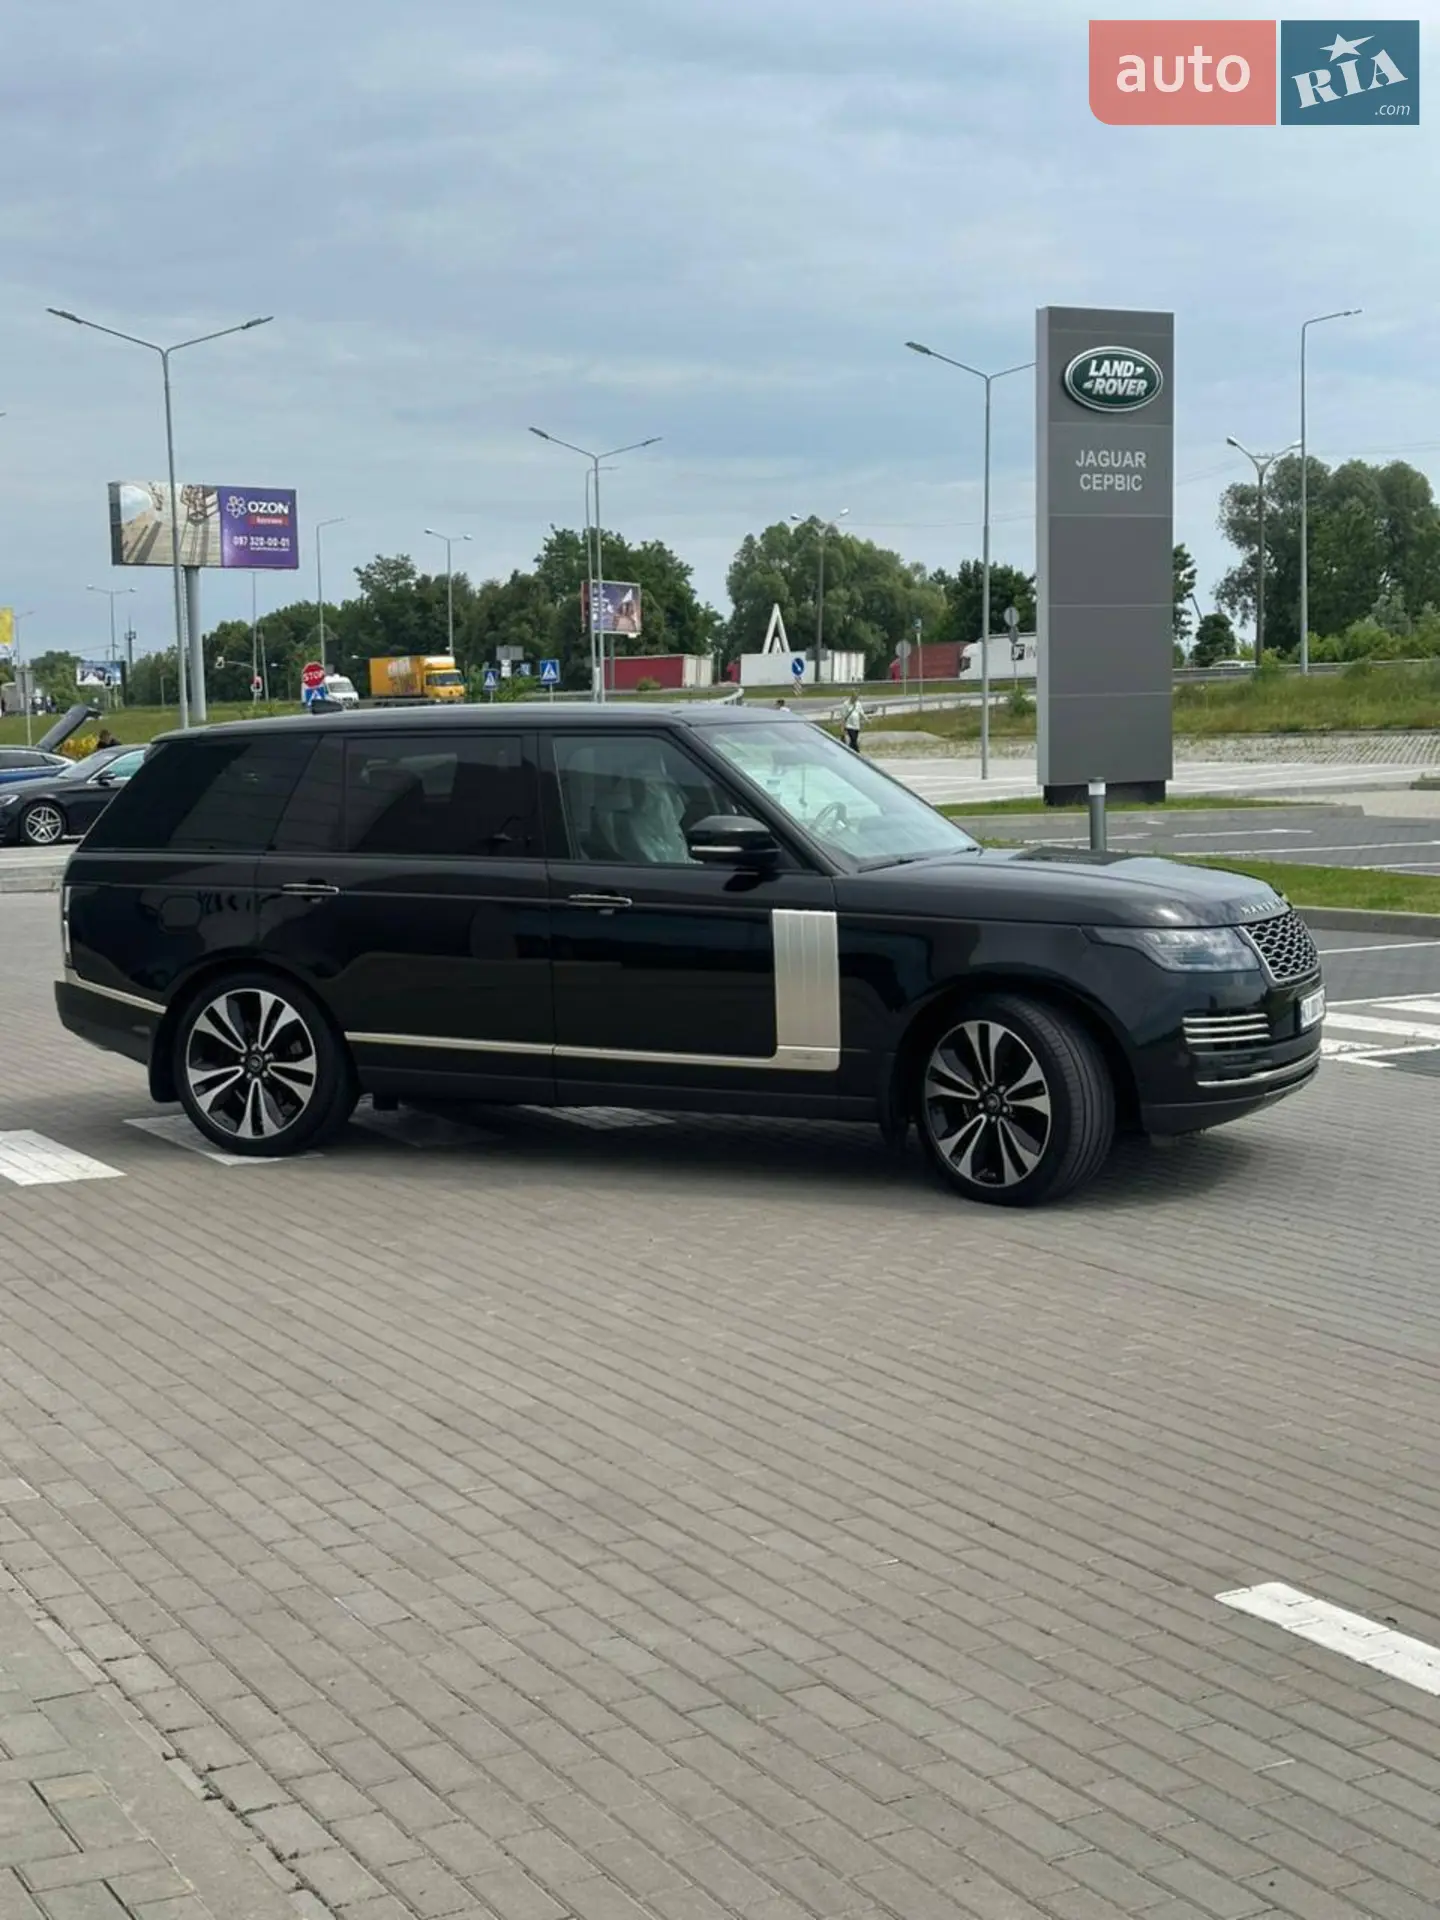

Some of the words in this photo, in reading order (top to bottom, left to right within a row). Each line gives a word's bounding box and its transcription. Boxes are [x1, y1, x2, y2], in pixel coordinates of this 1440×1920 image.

[1089, 359, 1135, 377] LAND
[1092, 378, 1148, 396] ROVER
[1075, 450, 1147, 468] JAGUAR
[1080, 473, 1143, 491] СЕРВІС
[247, 501, 289, 514] OZON
[303, 669, 324, 682] STOP
